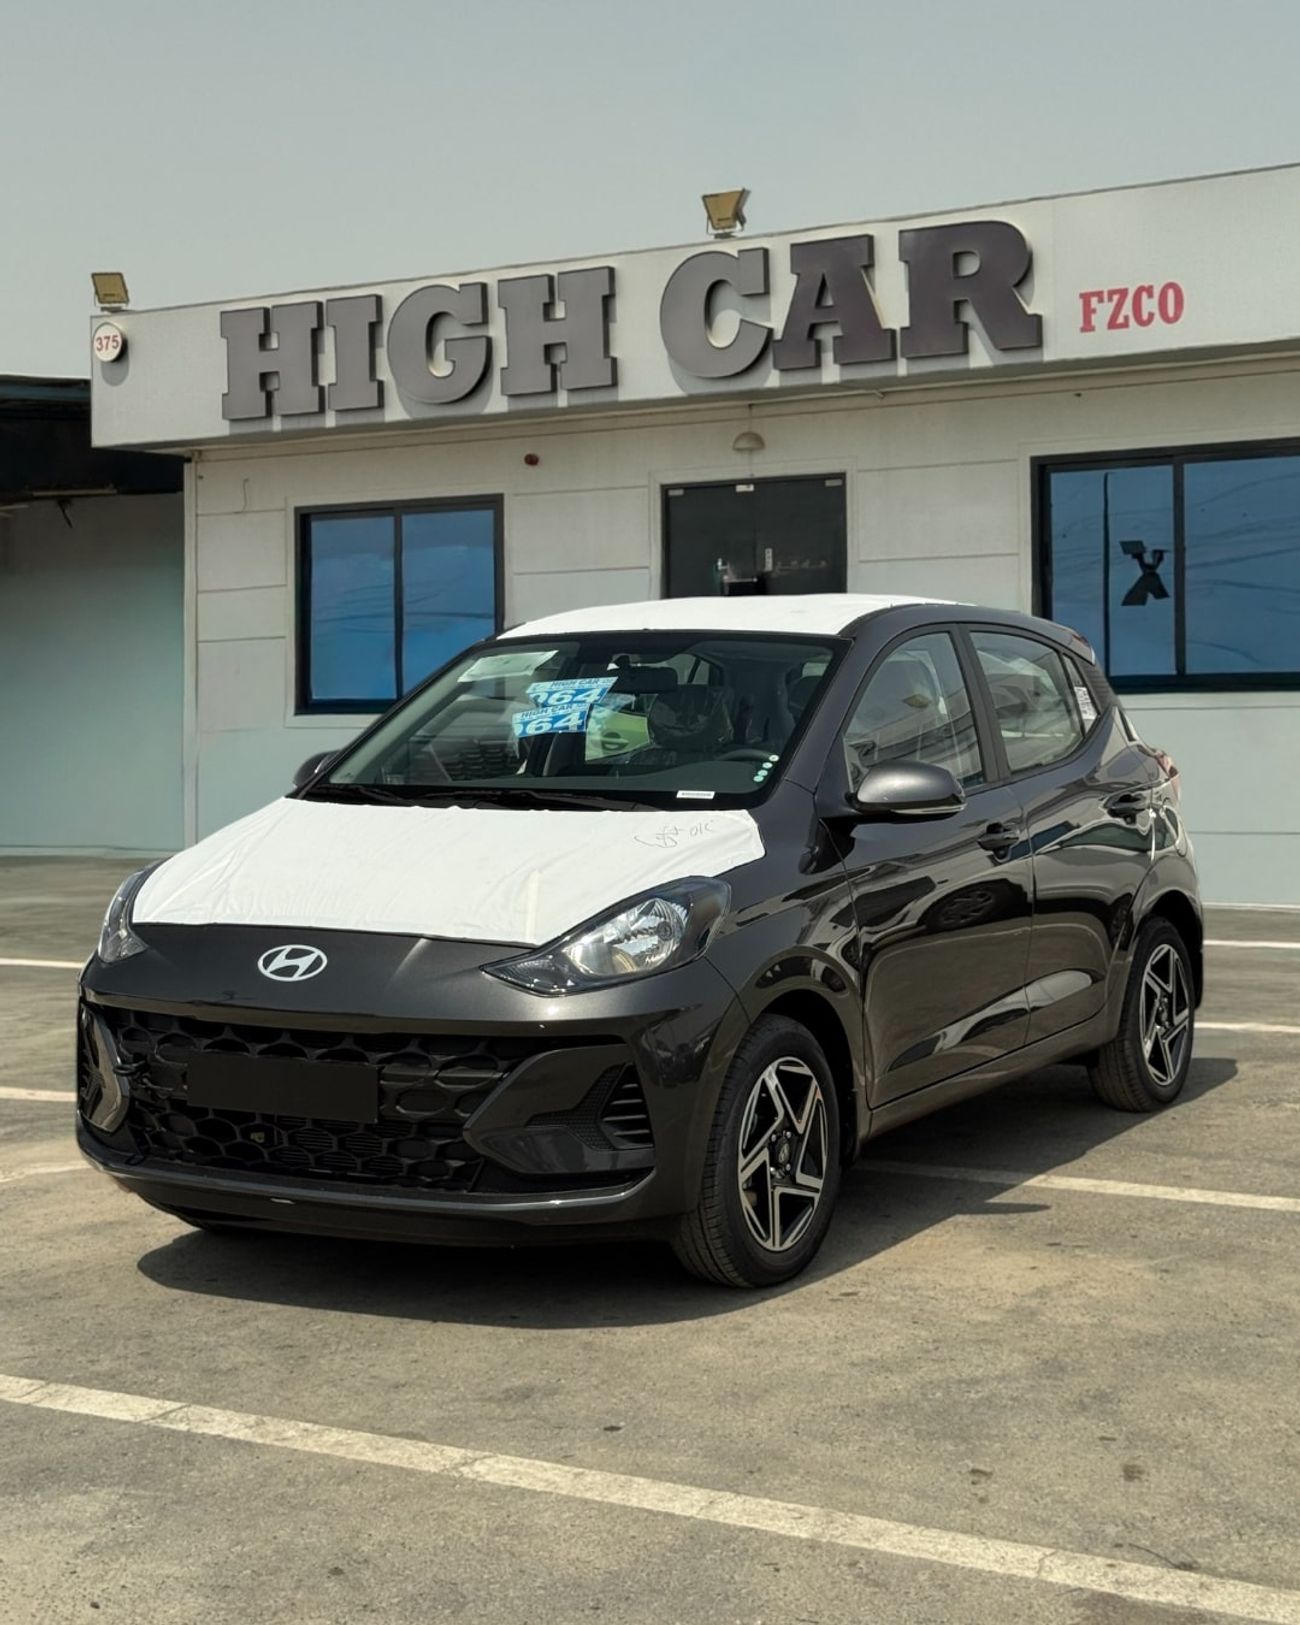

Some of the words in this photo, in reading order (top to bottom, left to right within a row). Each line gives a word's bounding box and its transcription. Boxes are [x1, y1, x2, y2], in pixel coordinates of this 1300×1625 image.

[96, 334, 120, 352] 375
[220, 265, 618, 420] HIGH
[660, 220, 1043, 378] CAR
[1079, 281, 1185, 333] FZCO
